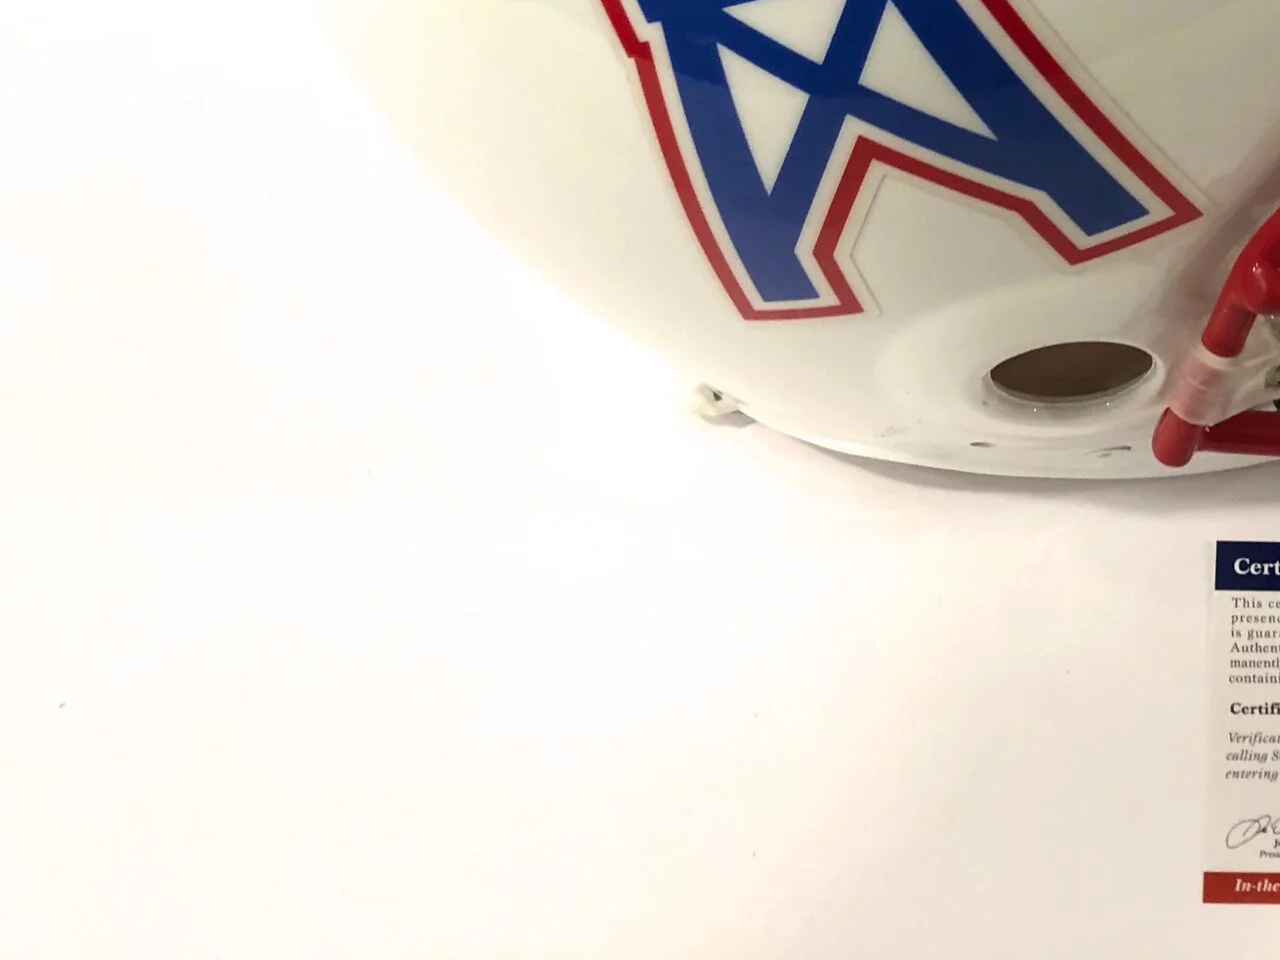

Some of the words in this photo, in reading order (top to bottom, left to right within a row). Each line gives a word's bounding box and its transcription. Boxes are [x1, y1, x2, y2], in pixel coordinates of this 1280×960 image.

[1232, 598, 1263, 610] This
[1231, 628, 1242, 639] is
[1226, 750, 1268, 764] calling
[1225, 768, 1279, 782] entering
